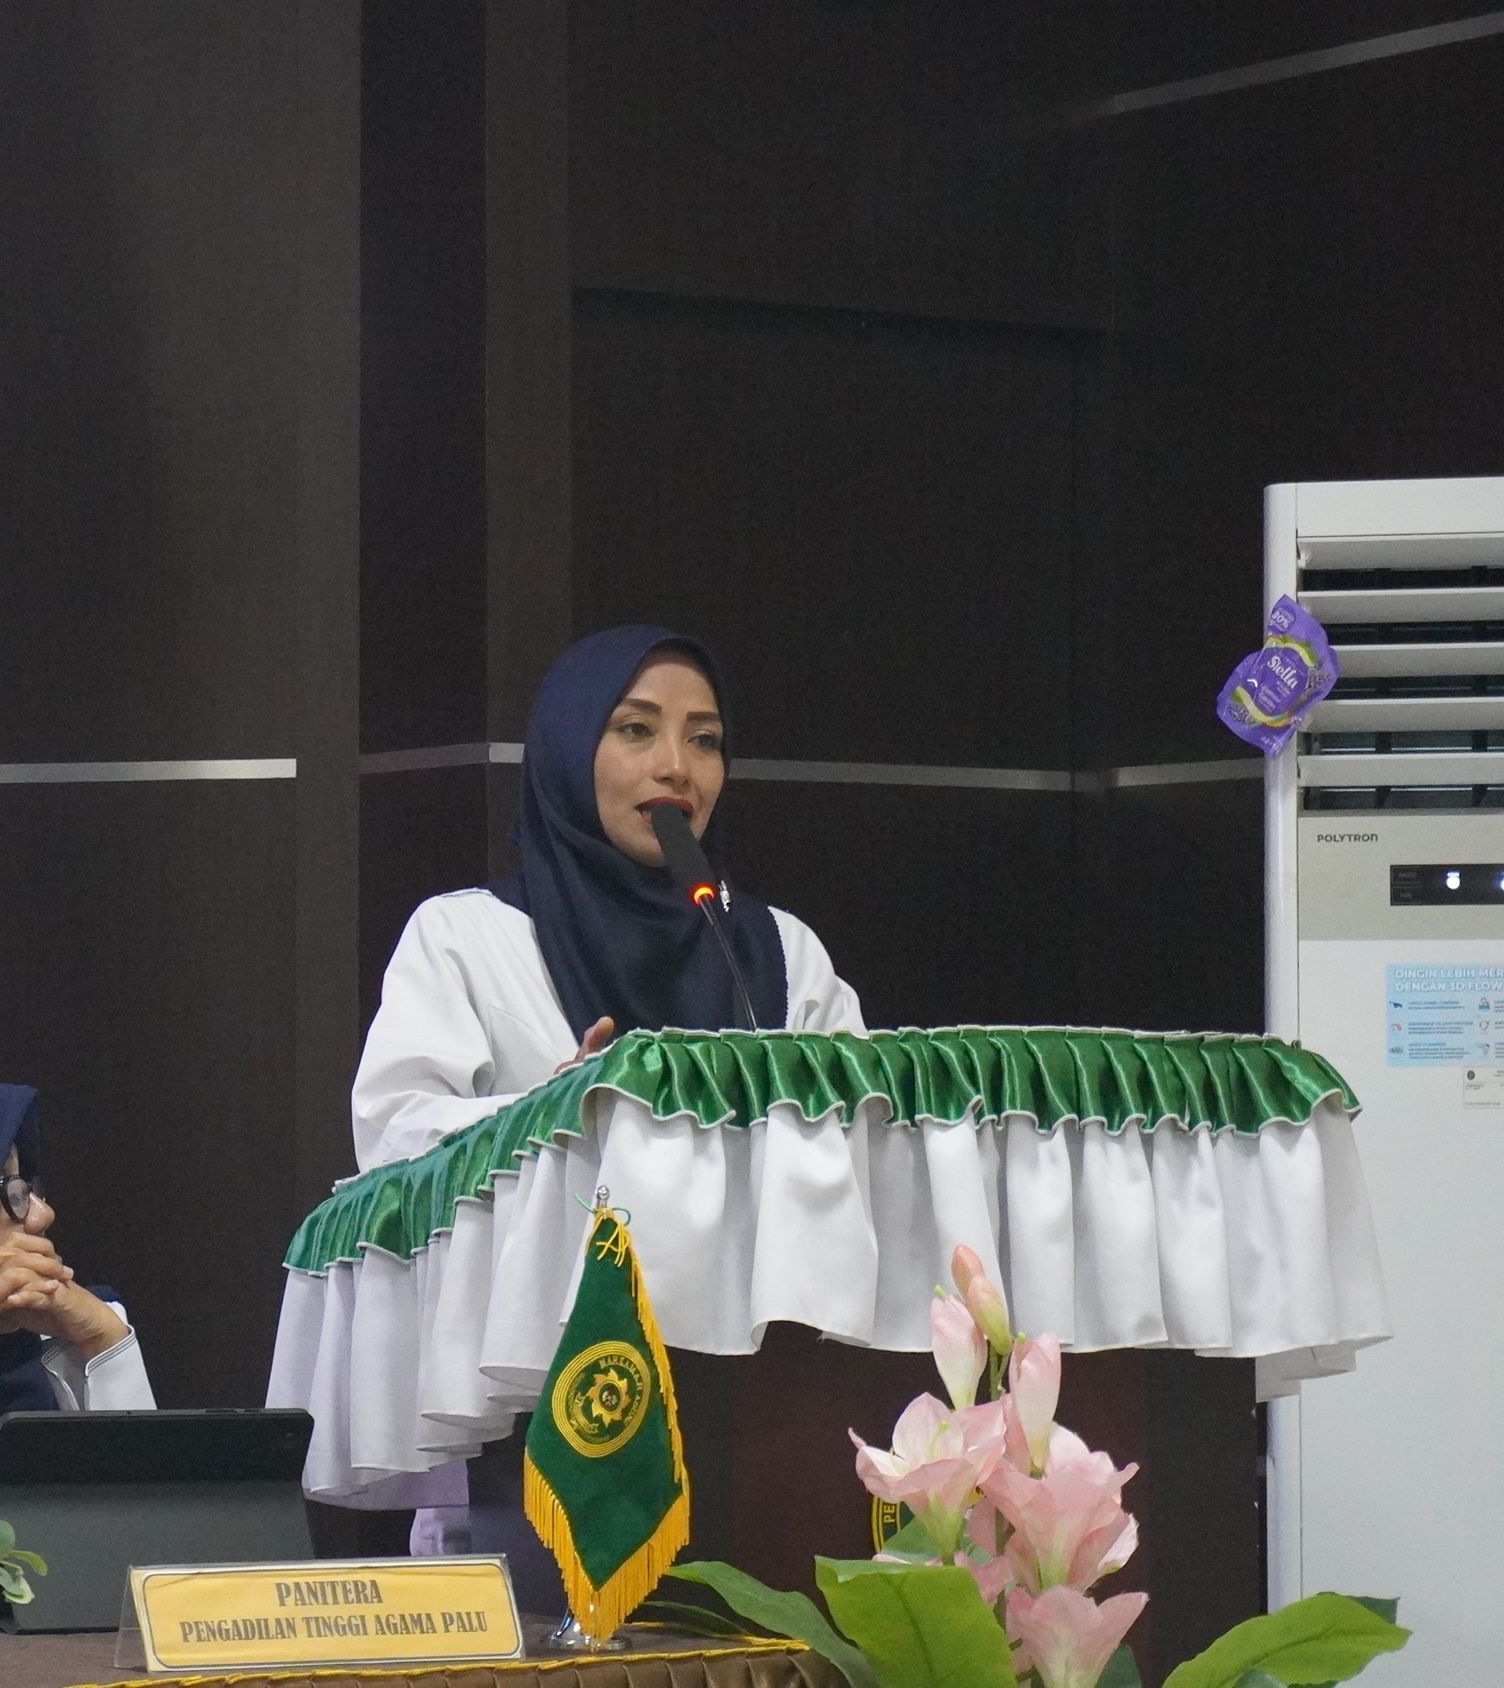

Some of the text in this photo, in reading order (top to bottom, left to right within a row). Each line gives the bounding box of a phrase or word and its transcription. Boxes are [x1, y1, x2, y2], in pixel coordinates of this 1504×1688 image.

[275, 1579, 384, 1607] PANITERA
[179, 1610, 489, 1643] PENGADILAN TINGGI AGAMA PALU
